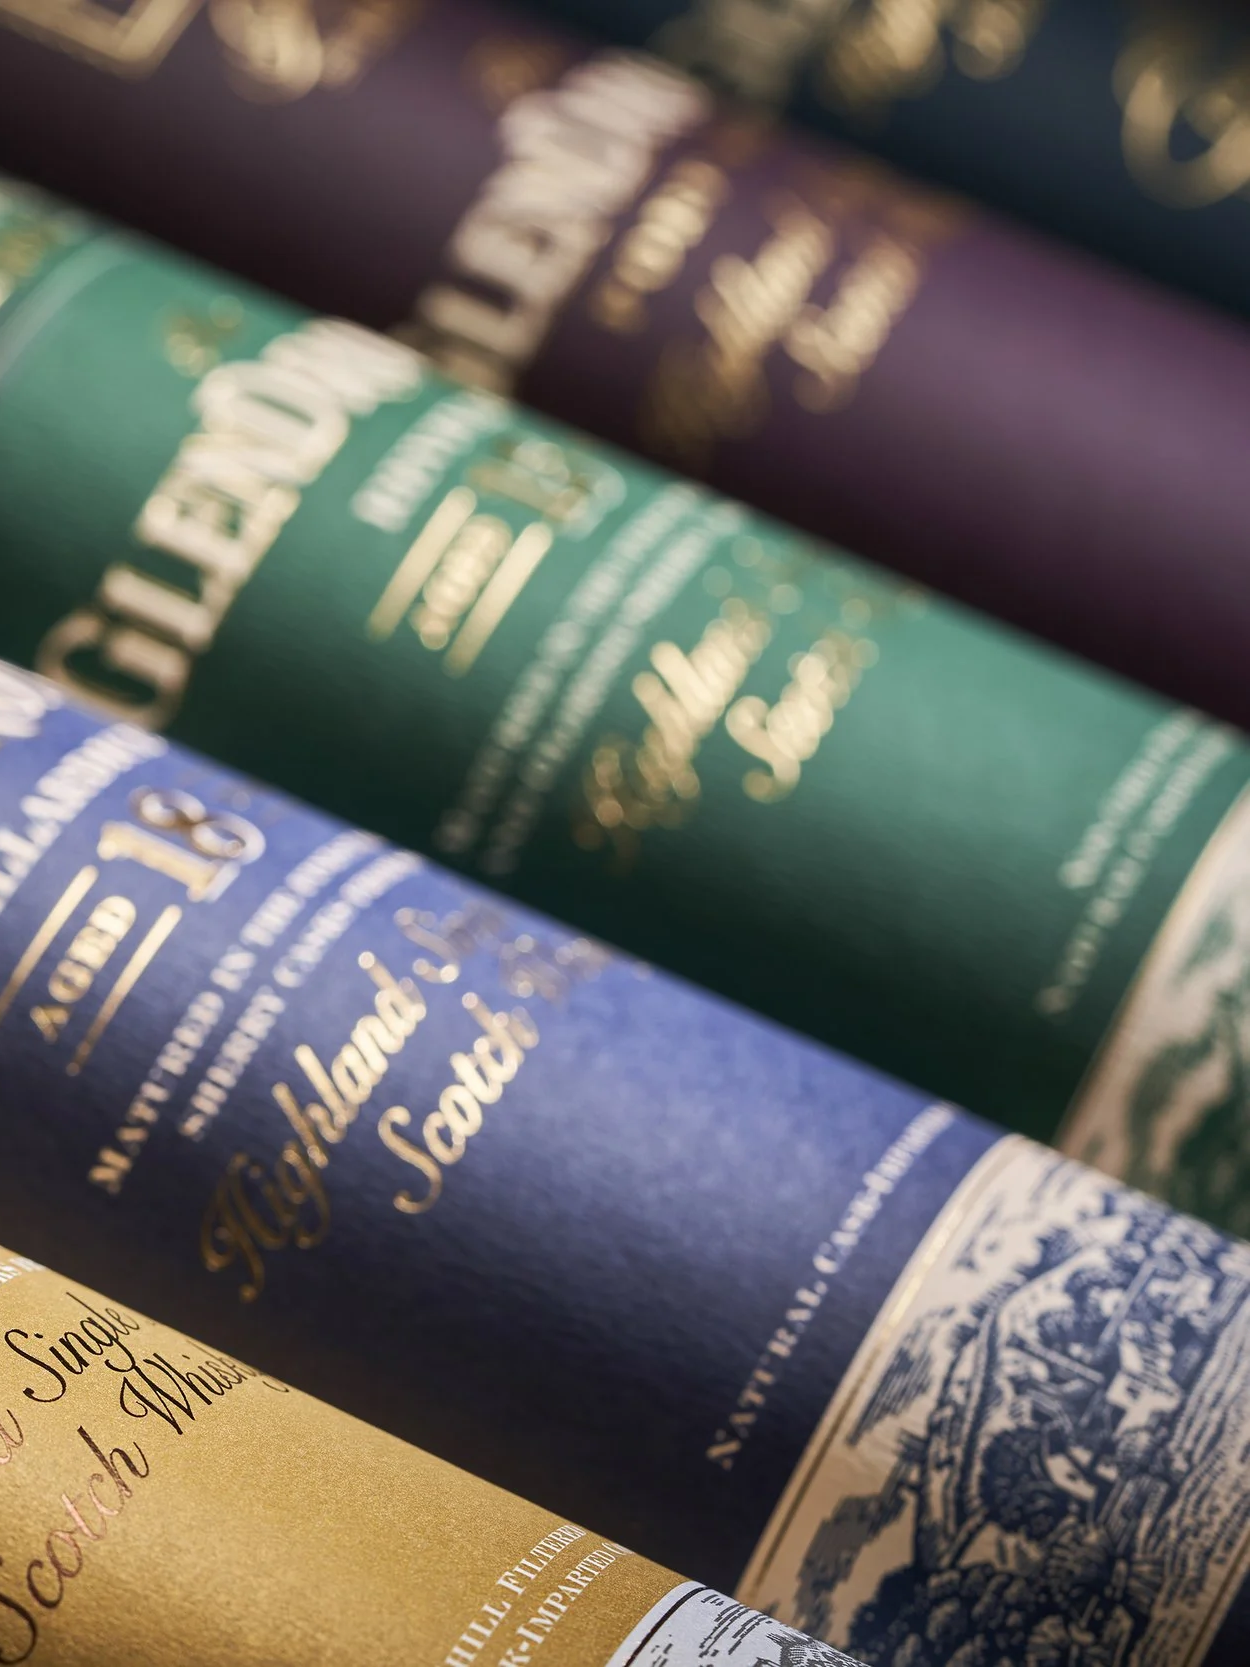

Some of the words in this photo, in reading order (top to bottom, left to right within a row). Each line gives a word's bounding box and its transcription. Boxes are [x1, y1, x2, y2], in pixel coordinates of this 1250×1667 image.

[97, 787, 266, 903] 18
[377, 992, 540, 1213] Scotch
[4, 1291, 140, 1403] Single
[496, 1524, 587, 1596] FILTERED
